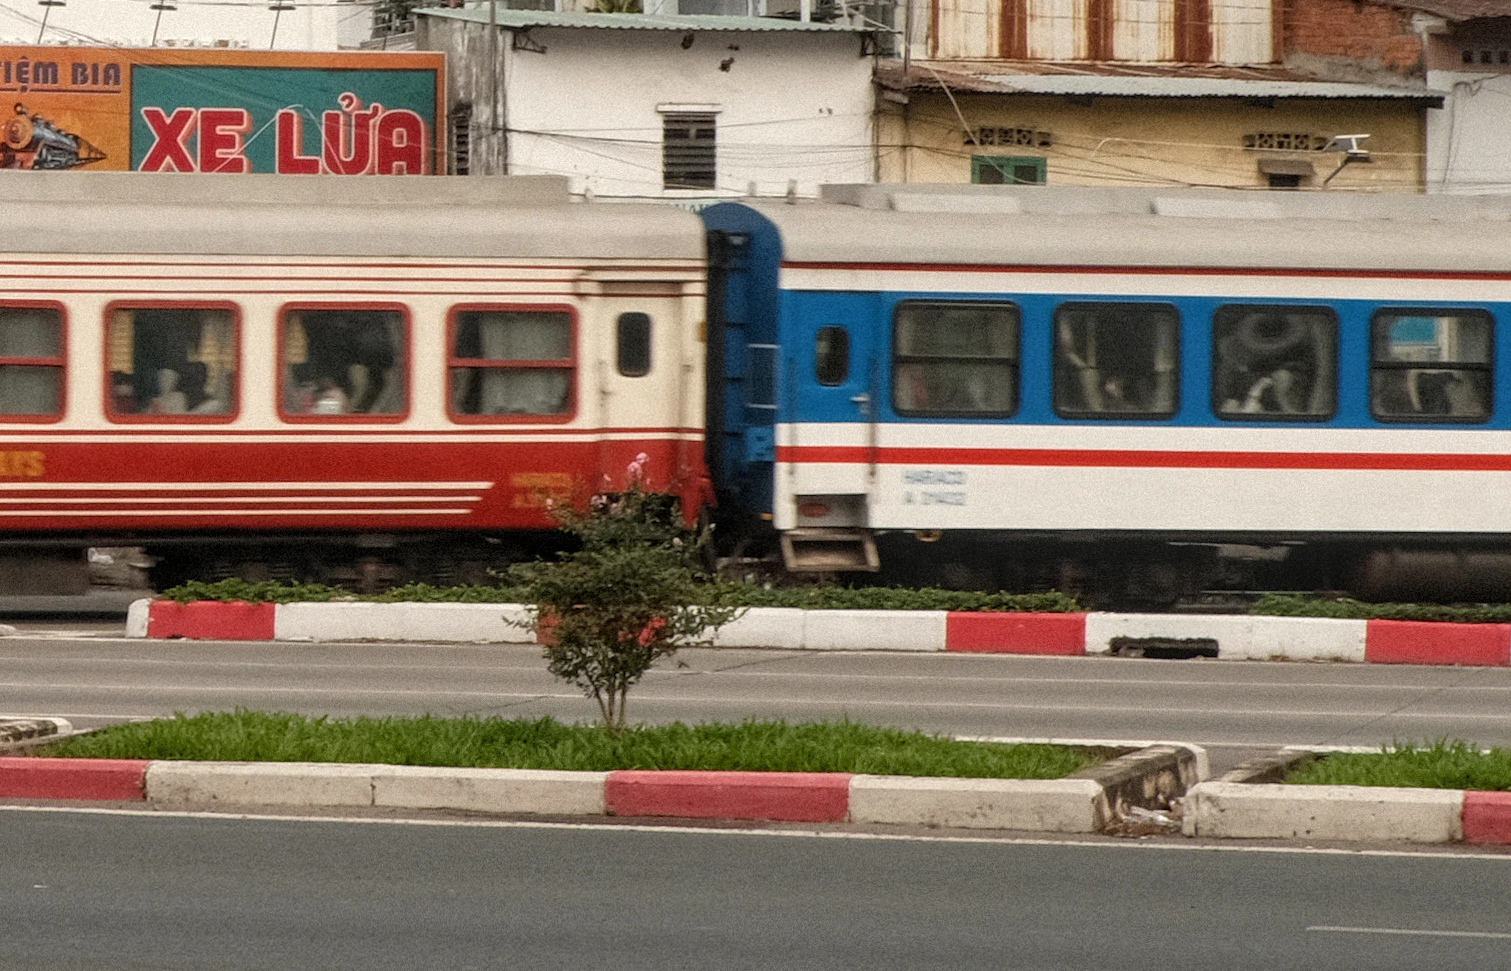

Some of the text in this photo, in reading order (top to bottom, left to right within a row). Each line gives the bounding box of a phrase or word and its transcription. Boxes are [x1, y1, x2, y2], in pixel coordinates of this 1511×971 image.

[71, 61, 121, 86] BIA
[140, 91, 429, 175] XE LỬA
